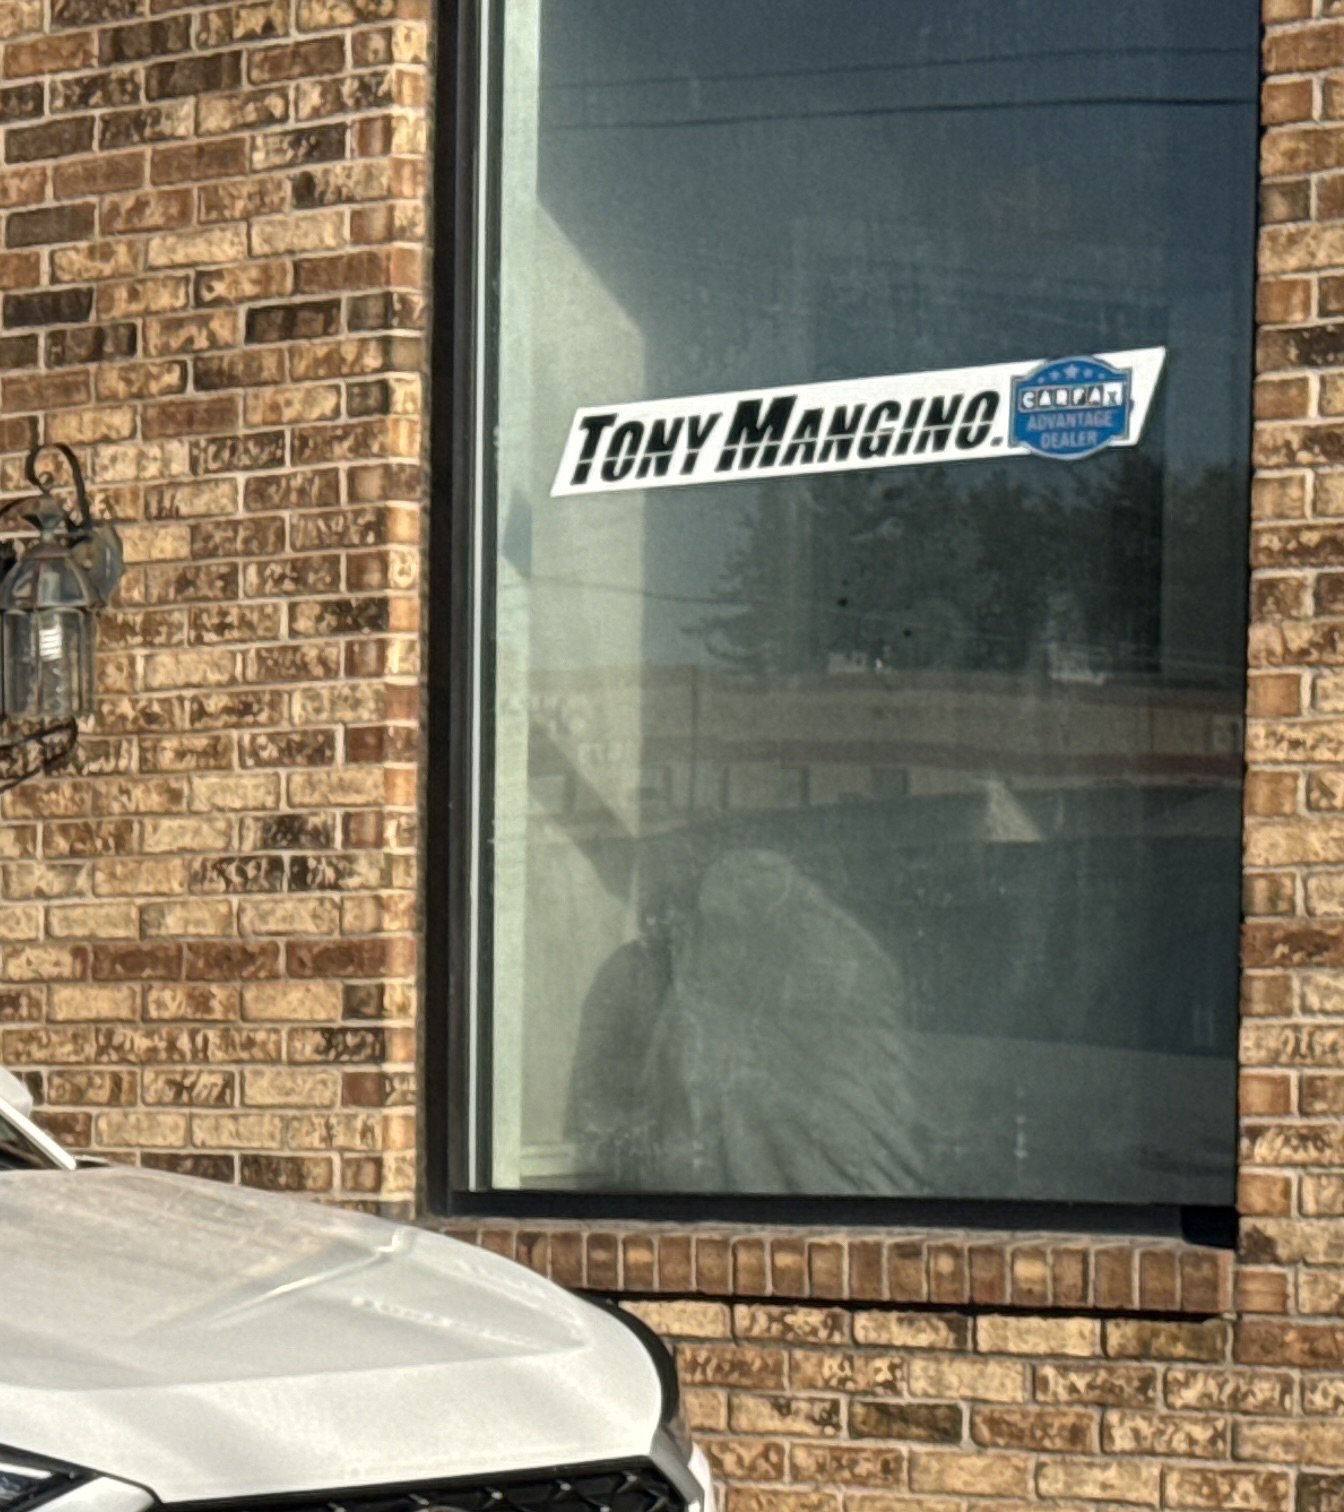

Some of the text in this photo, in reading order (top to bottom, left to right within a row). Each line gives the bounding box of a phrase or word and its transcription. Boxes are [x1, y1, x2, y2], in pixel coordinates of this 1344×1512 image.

[1020, 381, 1124, 411] CARFAX
[1025, 410, 1114, 431] ADVANTAGE
[568, 412, 723, 487] TONY
[1039, 429, 1098, 449] DEALER
